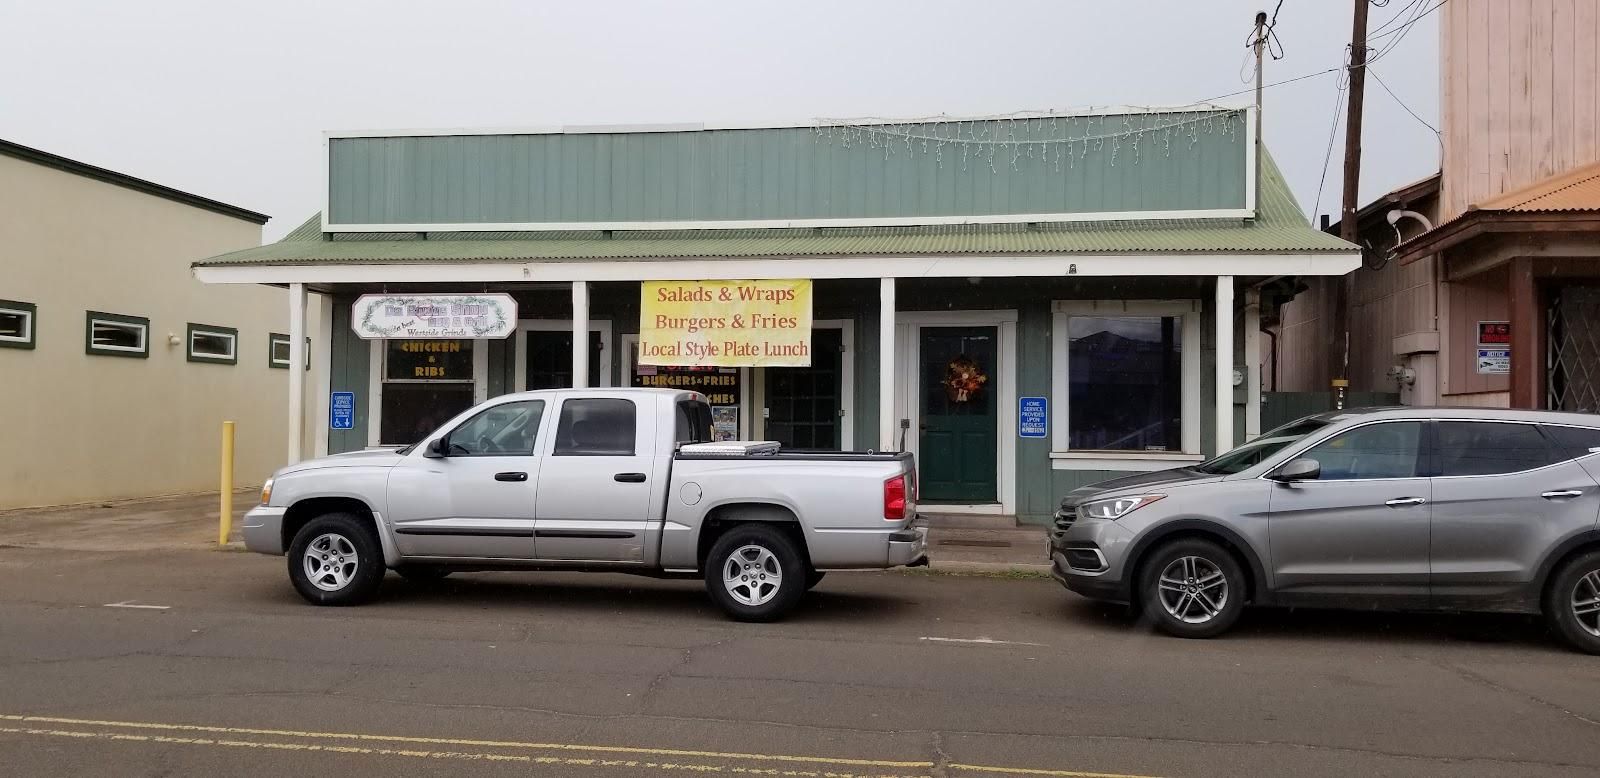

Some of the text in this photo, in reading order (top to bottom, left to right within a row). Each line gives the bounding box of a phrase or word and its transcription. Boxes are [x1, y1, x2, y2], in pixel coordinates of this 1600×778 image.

[657, 286, 795, 305] Salads & Wraps
[655, 313, 797, 334] Burgers & Fries
[407, 328, 466, 336] Westside Grinds
[401, 342, 460, 353] CHICKEN
[642, 341, 808, 360] Local Style Plate Lunch
[415, 366, 445, 377] RIBS
[642, 375, 696, 386] BURGERS
[703, 375, 736, 386] FRIES
[707, 394, 735, 404] CHES
